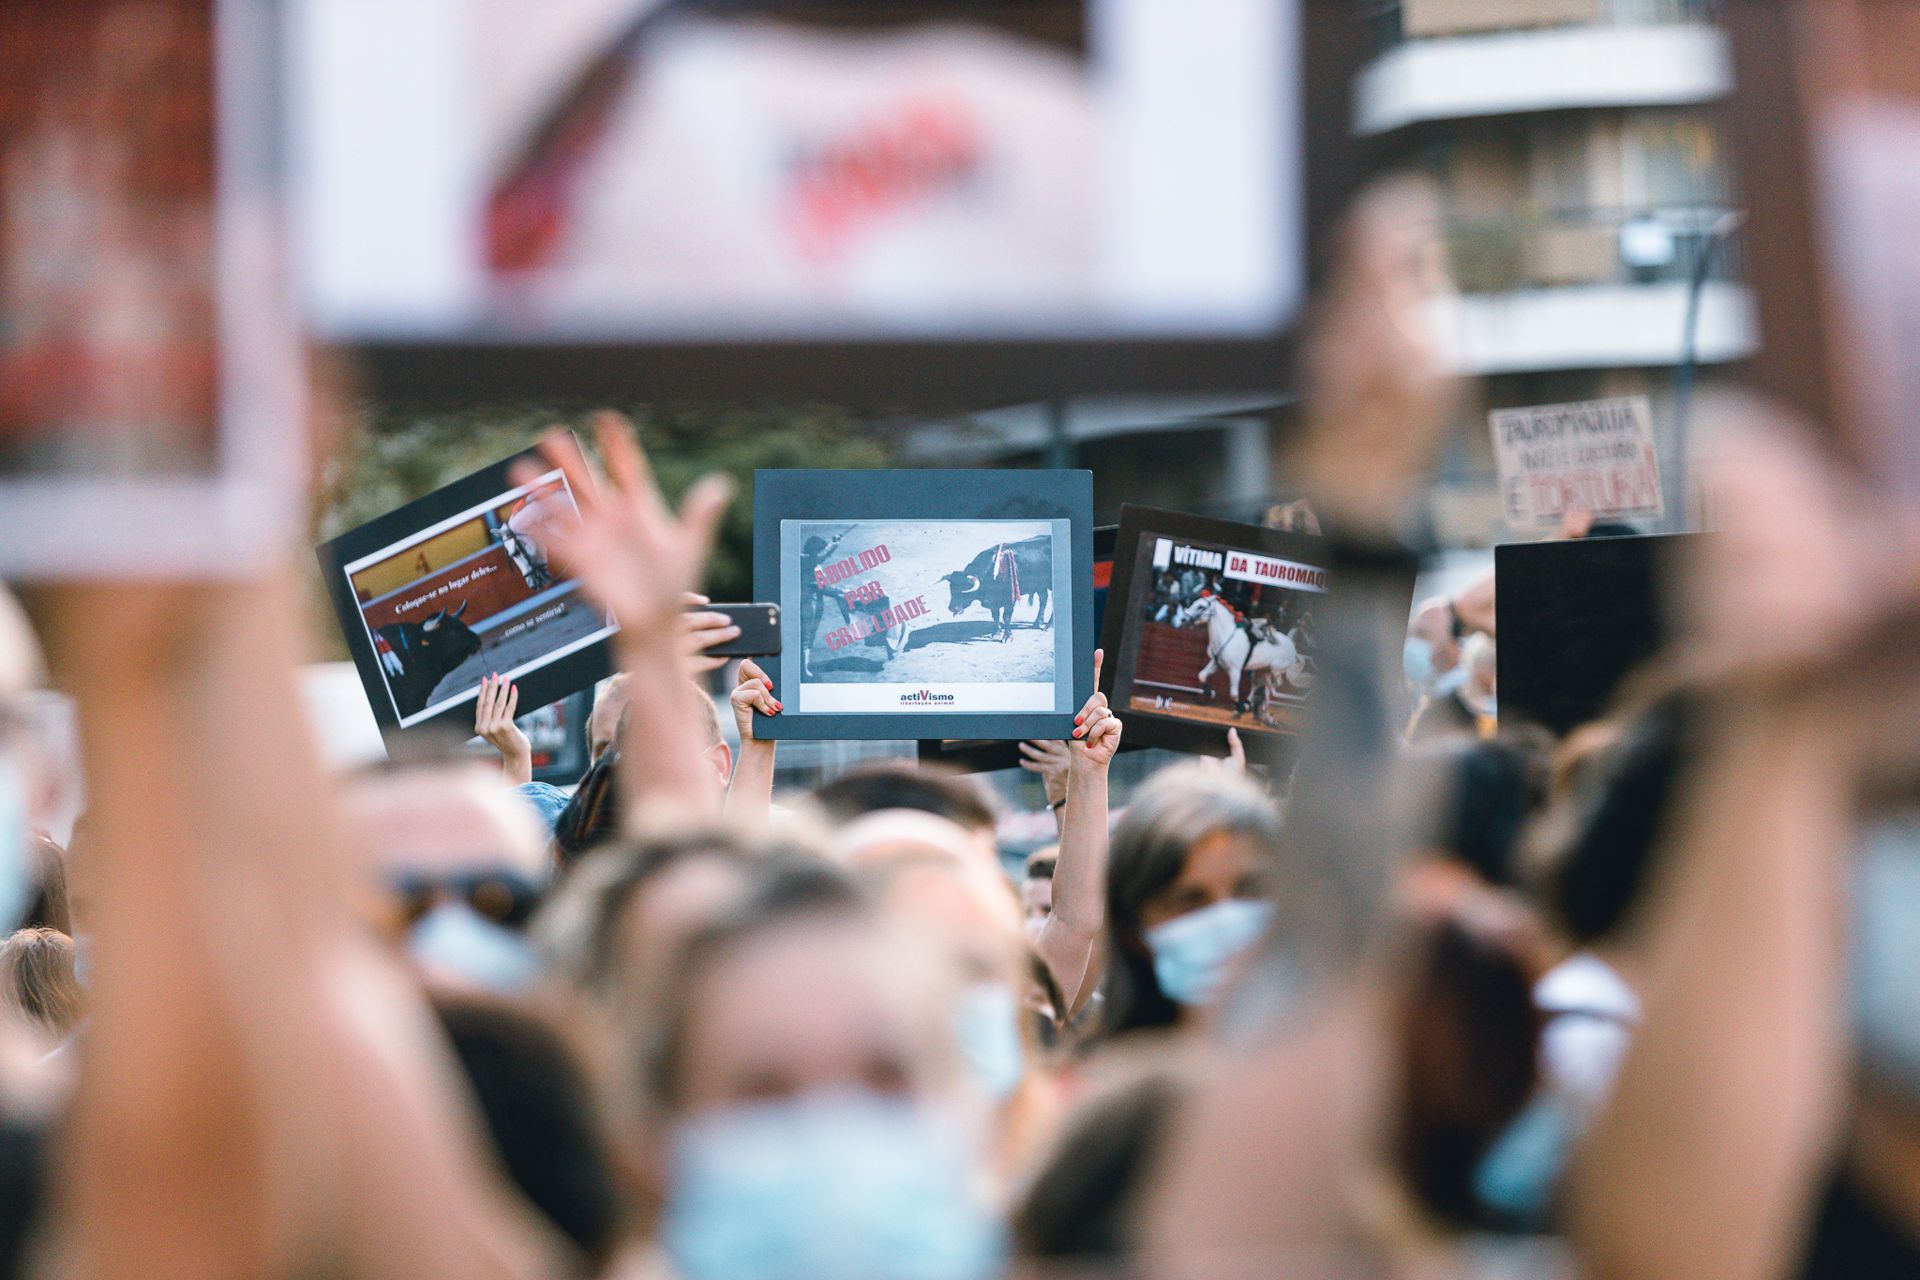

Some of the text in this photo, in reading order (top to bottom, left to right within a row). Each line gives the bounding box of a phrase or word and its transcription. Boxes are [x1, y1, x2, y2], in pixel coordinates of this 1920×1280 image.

[814, 544, 891, 589] ABOLIDO
[1174, 545, 1223, 570] VÍTIMA
[448, 575, 469, 590] lugar
[1231, 557, 1329, 590] DA TAUROMAQ
[843, 580, 885, 610] POR
[824, 594, 931, 651] CRUELDADE
